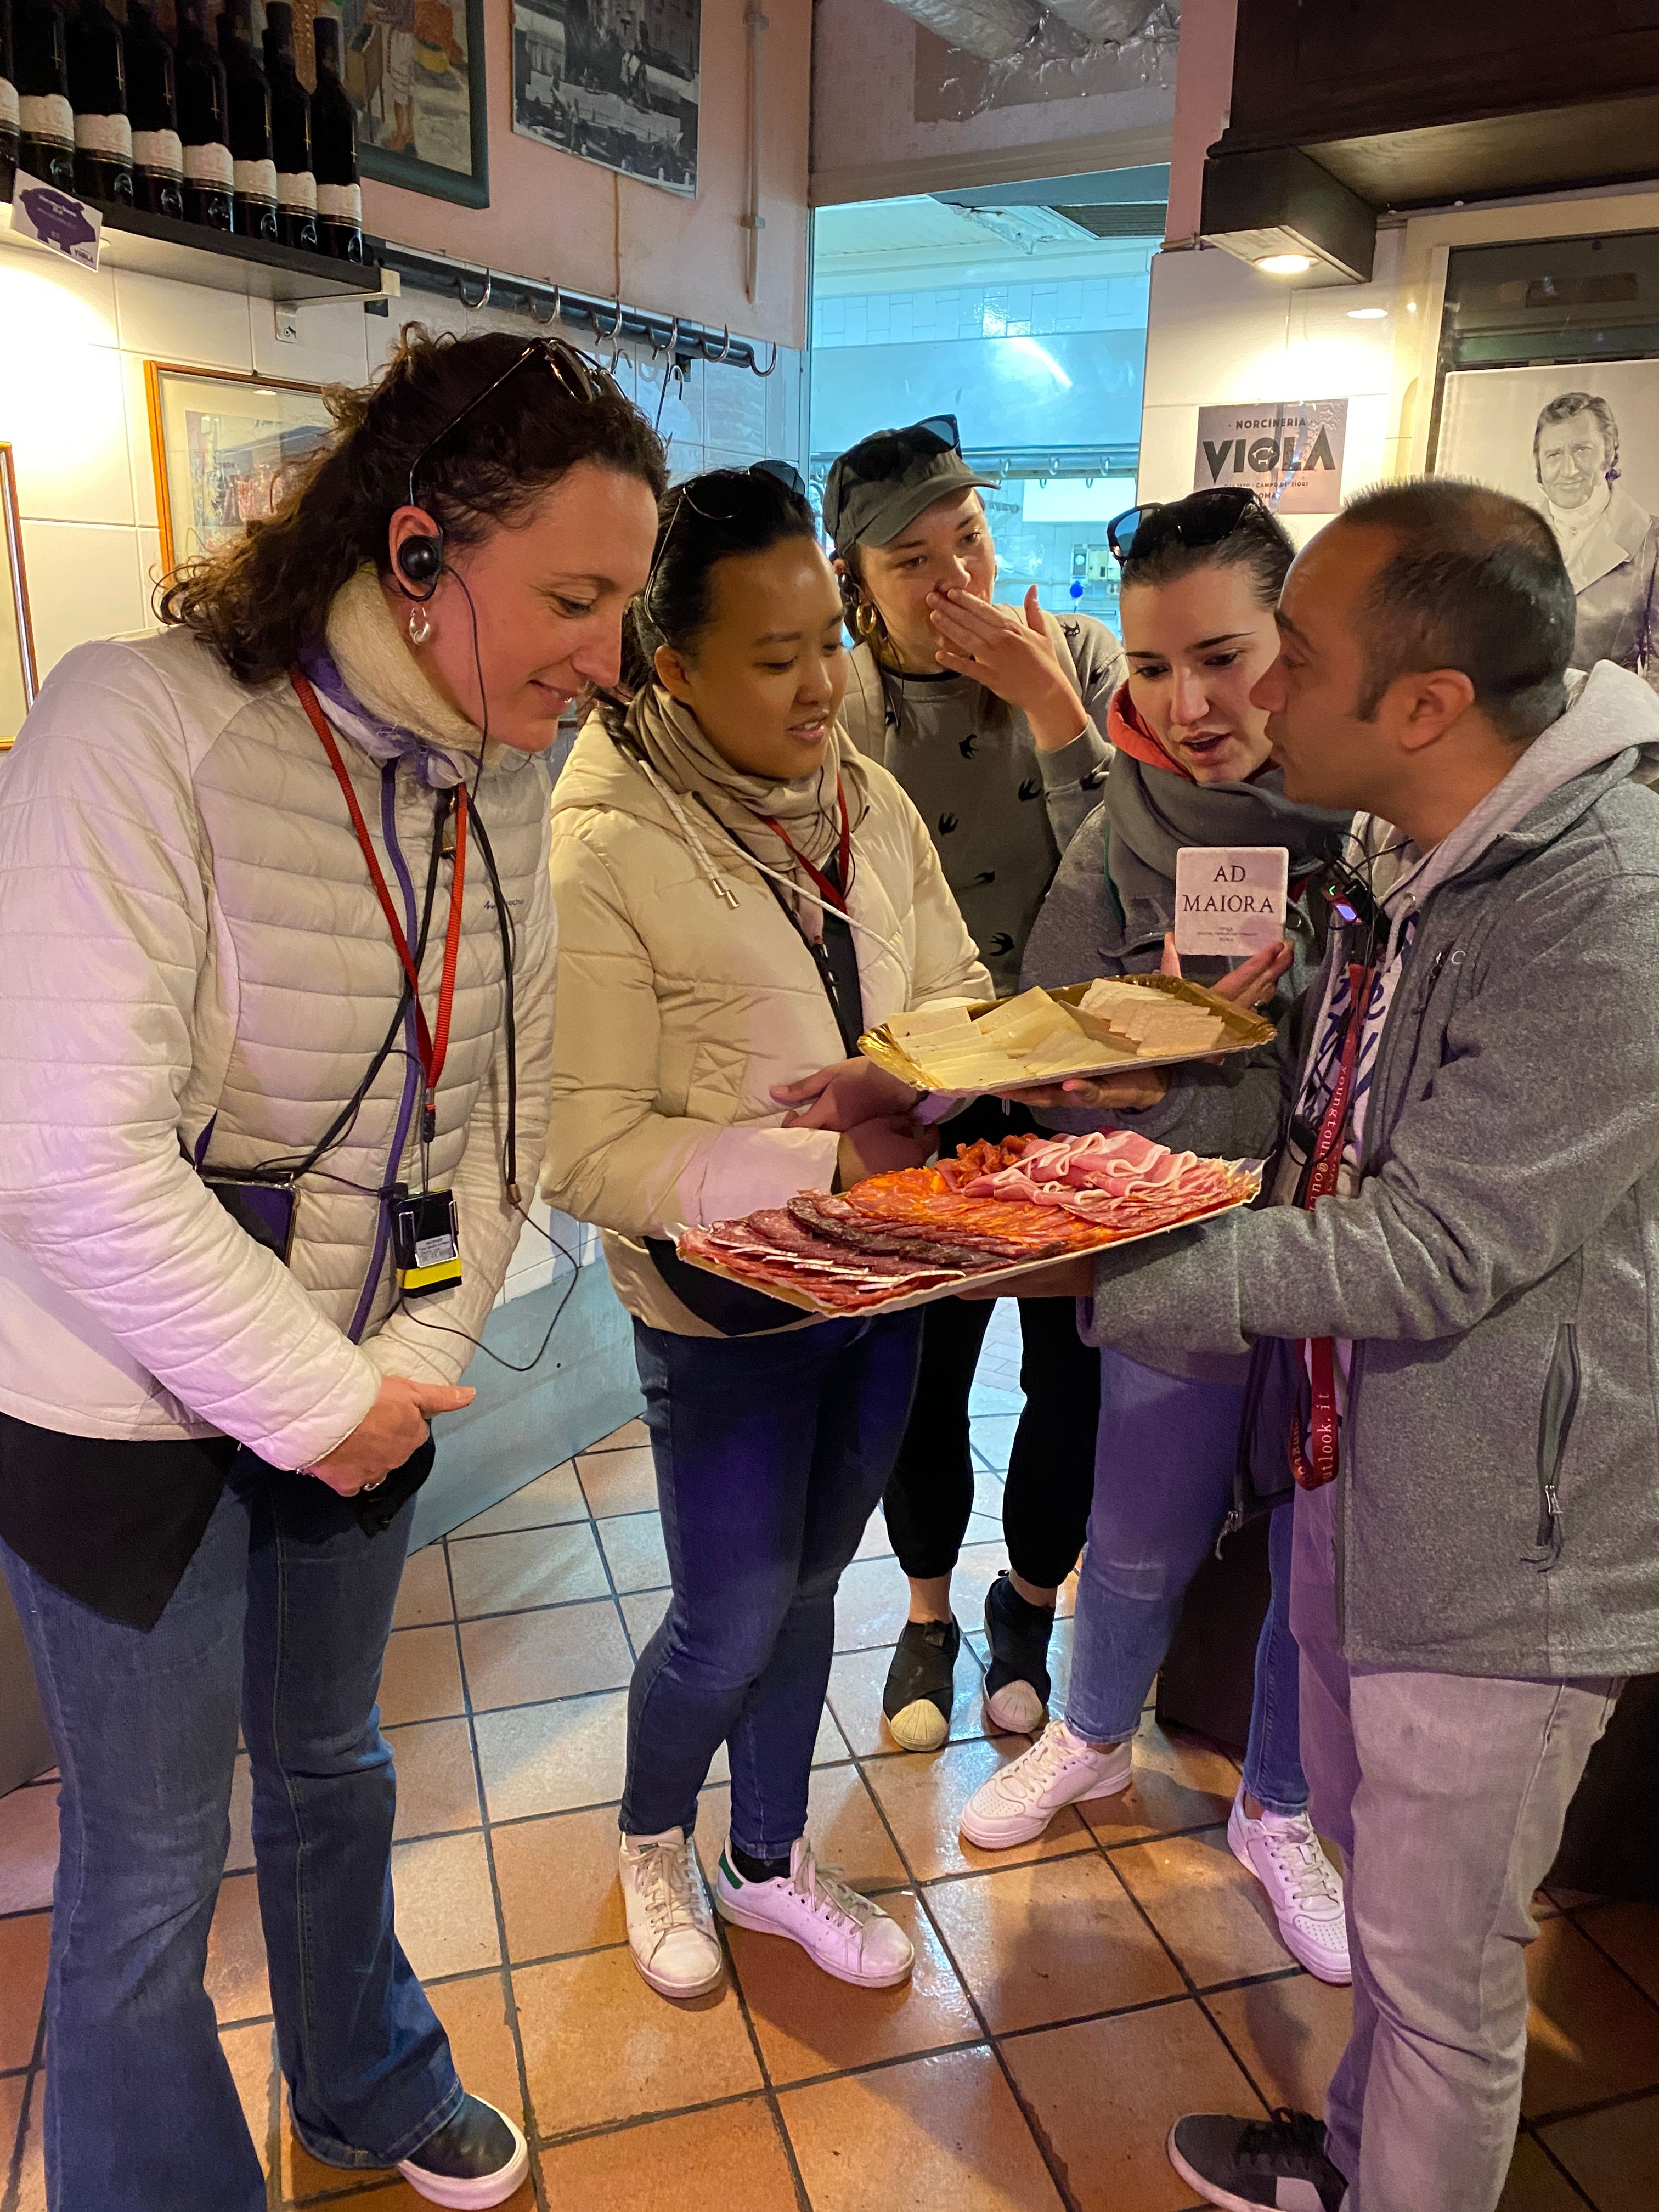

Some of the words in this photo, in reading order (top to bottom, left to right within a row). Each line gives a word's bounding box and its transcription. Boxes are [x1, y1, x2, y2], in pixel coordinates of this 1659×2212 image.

[1236, 417, 1306, 430] NORCINERIA
[1203, 424, 1336, 484] VIOLA
[1212, 865, 1246, 882] AD
[1183, 895, 1274, 913] MAIORA
